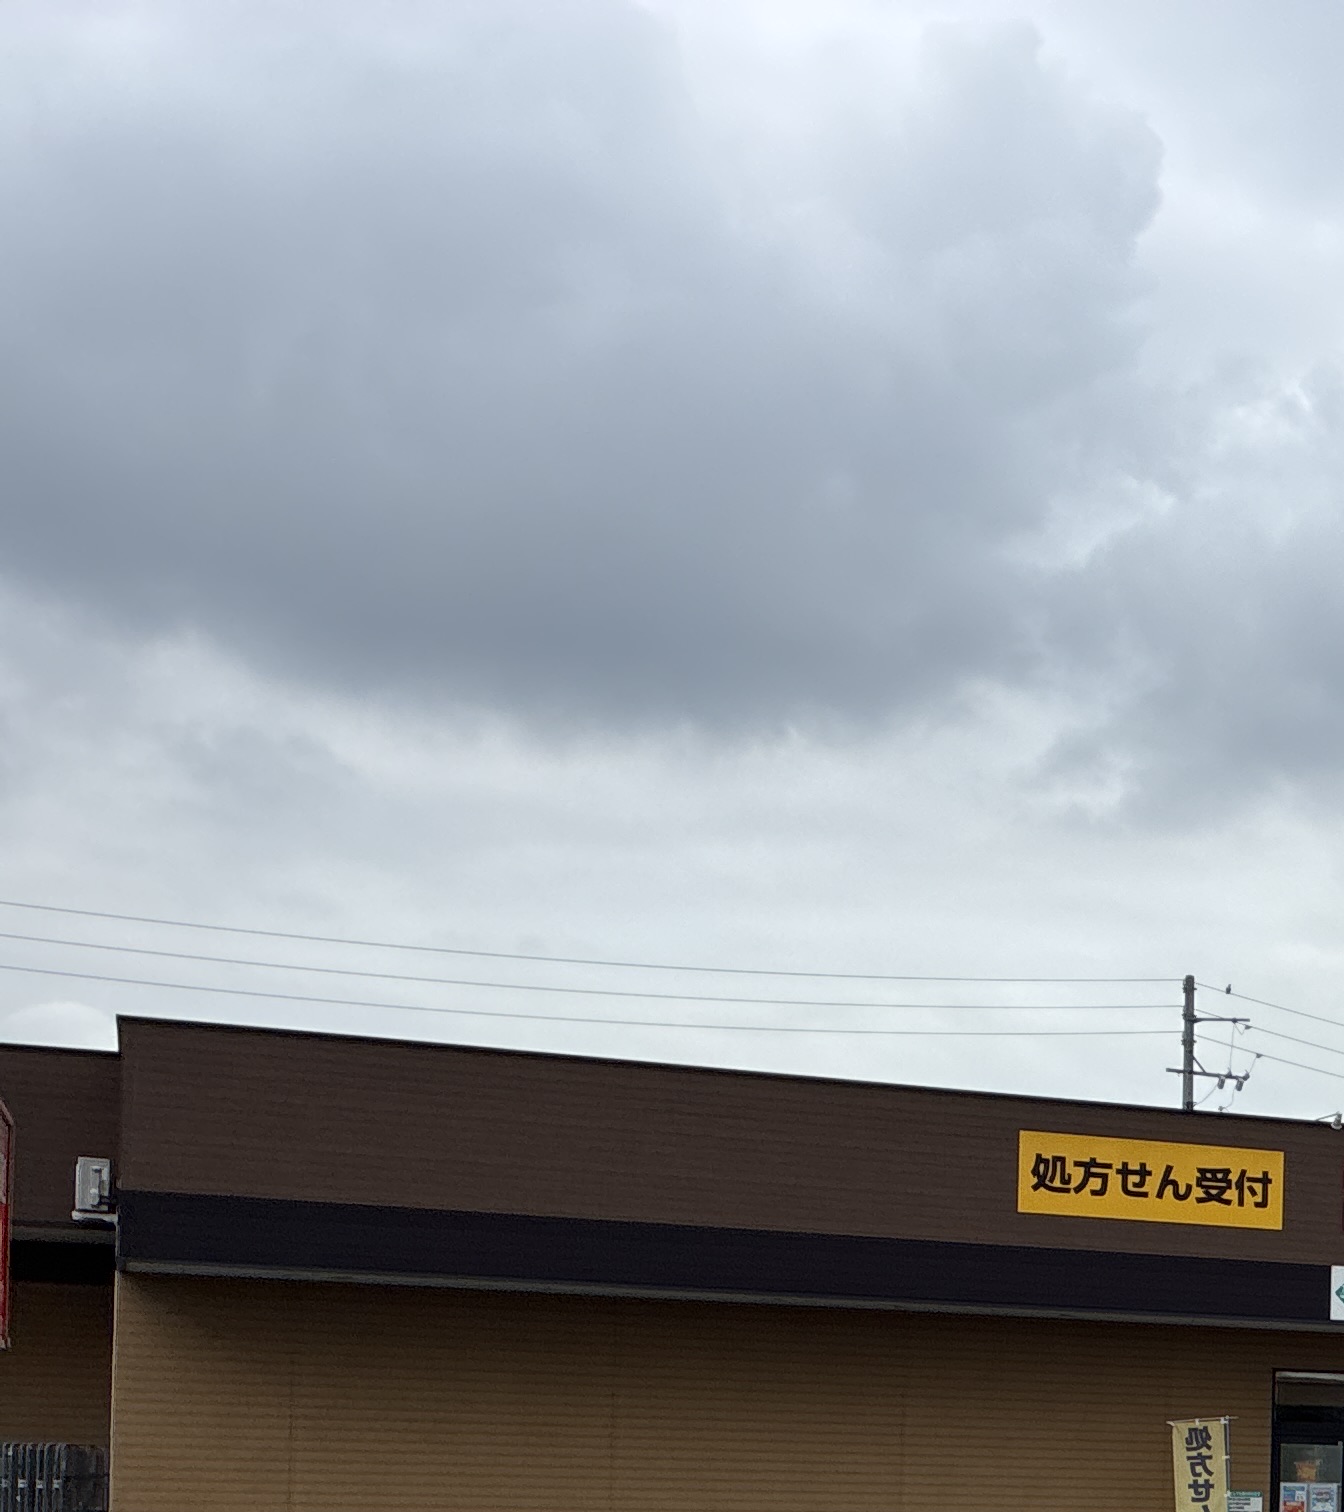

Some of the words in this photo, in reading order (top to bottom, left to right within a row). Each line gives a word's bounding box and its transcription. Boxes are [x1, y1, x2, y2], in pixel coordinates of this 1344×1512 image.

[1029, 1152, 1273, 1209] 処方せん受付
